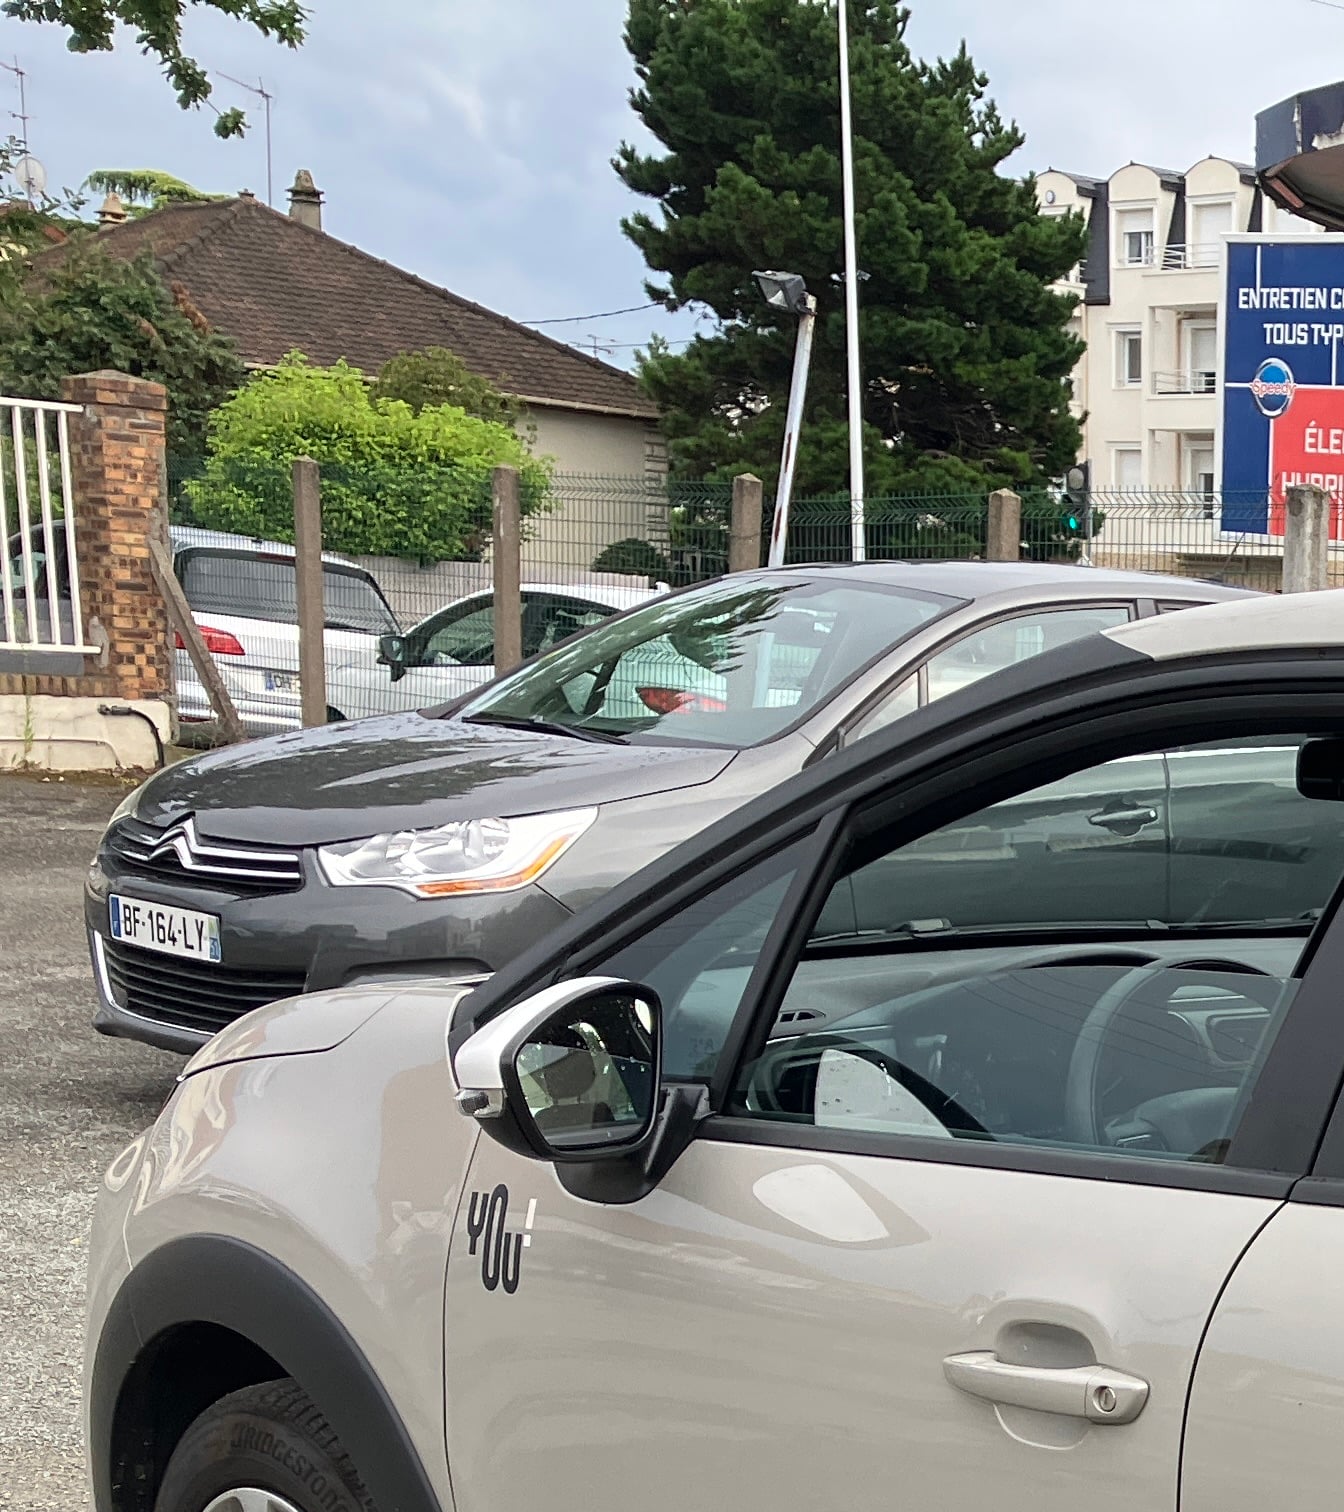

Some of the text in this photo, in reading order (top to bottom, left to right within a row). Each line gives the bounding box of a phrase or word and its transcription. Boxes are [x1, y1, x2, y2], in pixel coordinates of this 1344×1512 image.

[1238, 287, 1328, 310] ENTRETIEN
[1263, 323, 1309, 345] TOUS
[1250, 378, 1296, 399] Speedy
[122, 903, 205, 953] BF-164-LY
